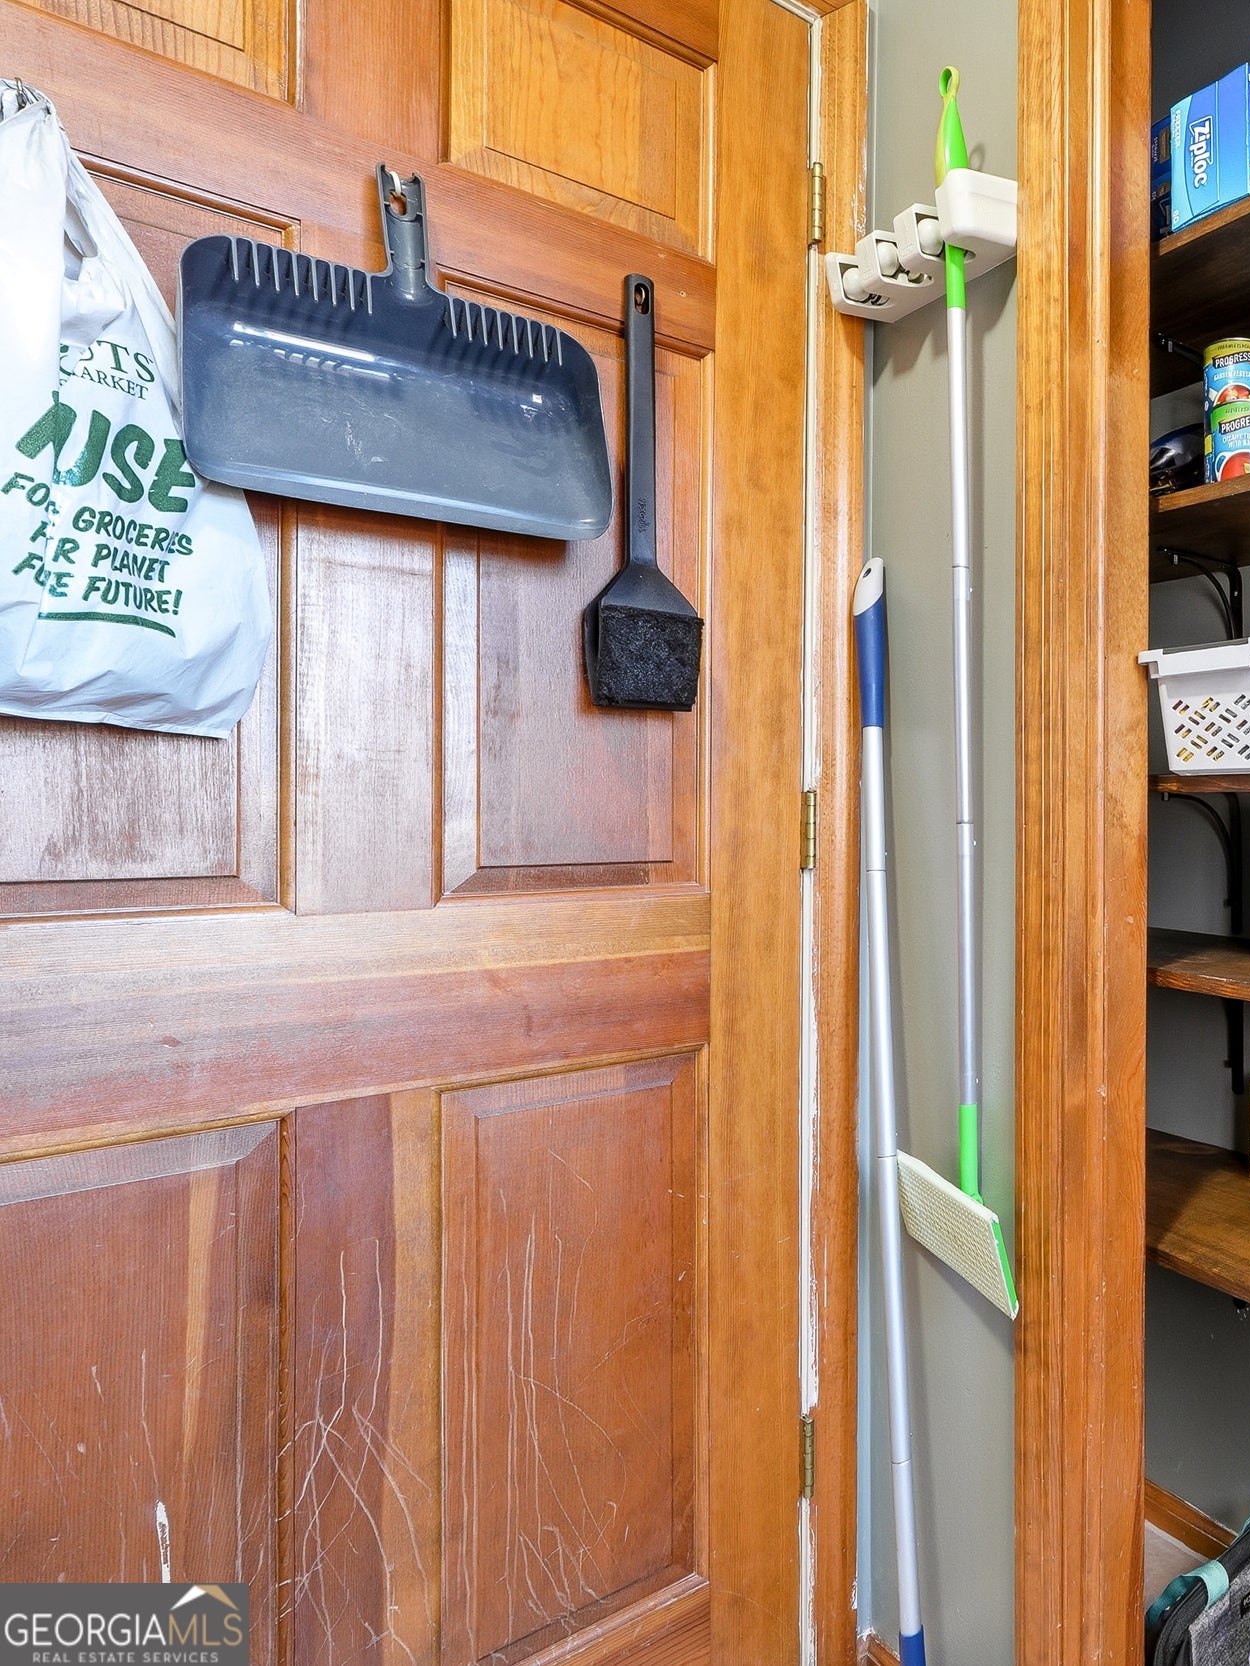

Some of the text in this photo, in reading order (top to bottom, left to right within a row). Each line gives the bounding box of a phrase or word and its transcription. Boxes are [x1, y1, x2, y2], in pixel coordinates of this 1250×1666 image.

[1189, 120, 1211, 188] Ziploc
[91, 543, 170, 583] PLANET
[82, 575, 183, 616] FUTURE!
